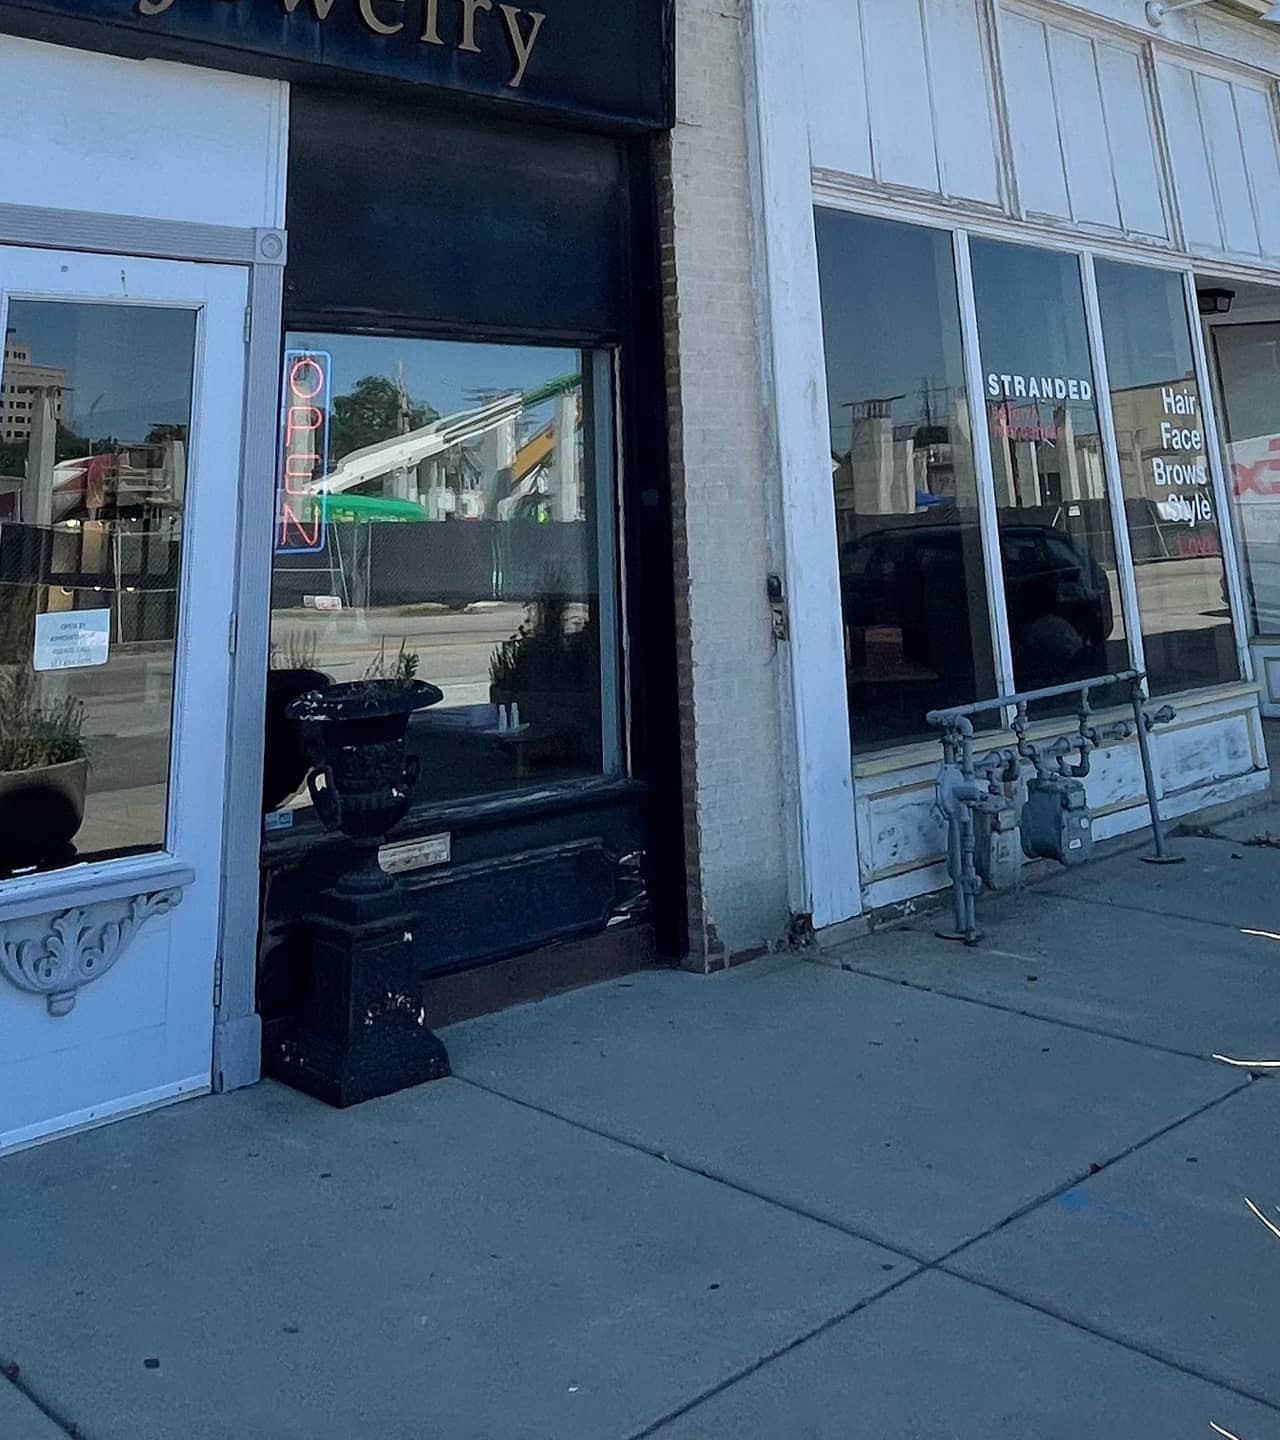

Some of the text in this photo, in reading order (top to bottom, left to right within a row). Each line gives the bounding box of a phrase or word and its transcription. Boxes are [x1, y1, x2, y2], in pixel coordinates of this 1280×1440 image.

[987, 373, 1092, 401] STRANDED
[1160, 387, 1197, 416] Hair
[1160, 422, 1202, 450] Face
[280, 357, 323, 546] OPEN
[1151, 457, 1207, 486] Brows
[1167, 492, 1213, 527] Style
